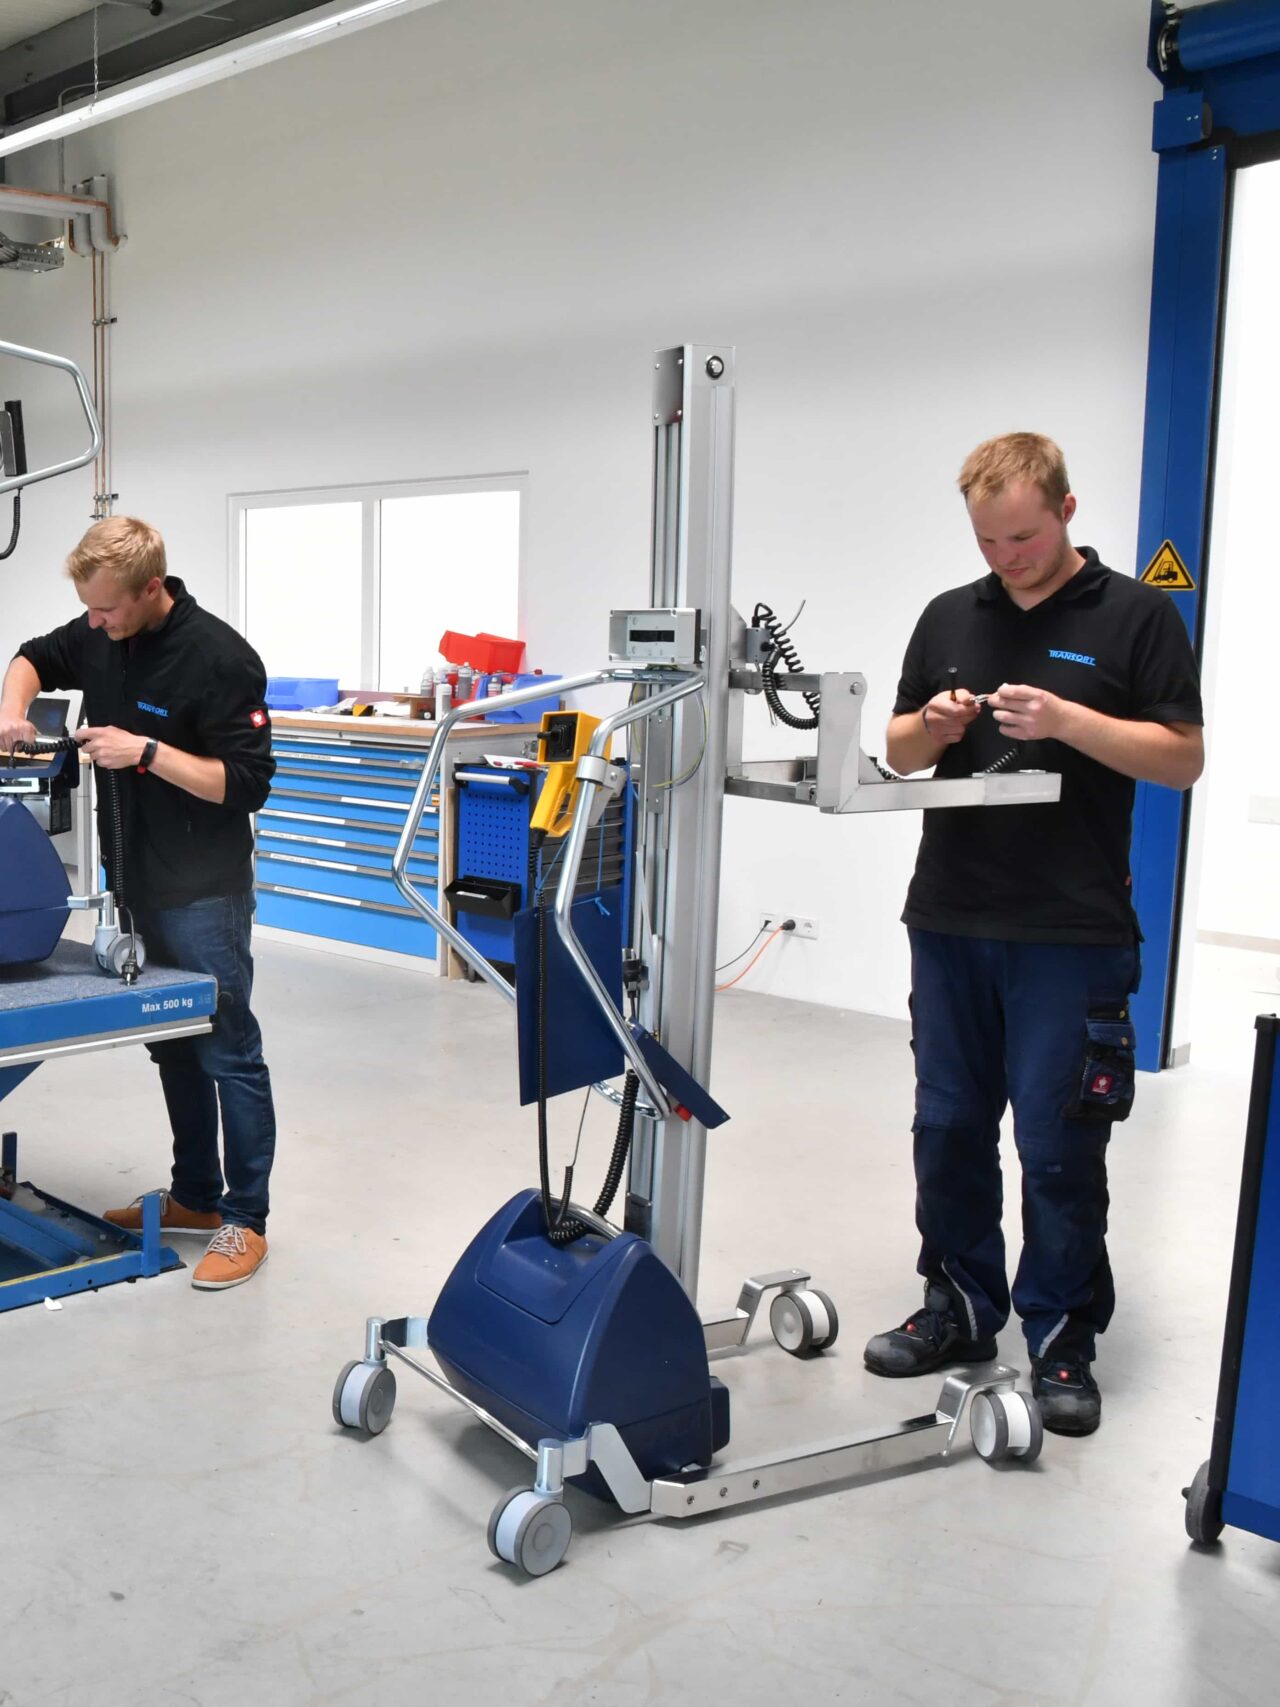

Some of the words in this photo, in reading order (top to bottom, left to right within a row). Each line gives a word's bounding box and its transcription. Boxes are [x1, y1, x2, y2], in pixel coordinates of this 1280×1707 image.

[141, 1003, 161, 1013] Max
[163, 999, 180, 1010] 500
[181, 998, 193, 1008] kg
